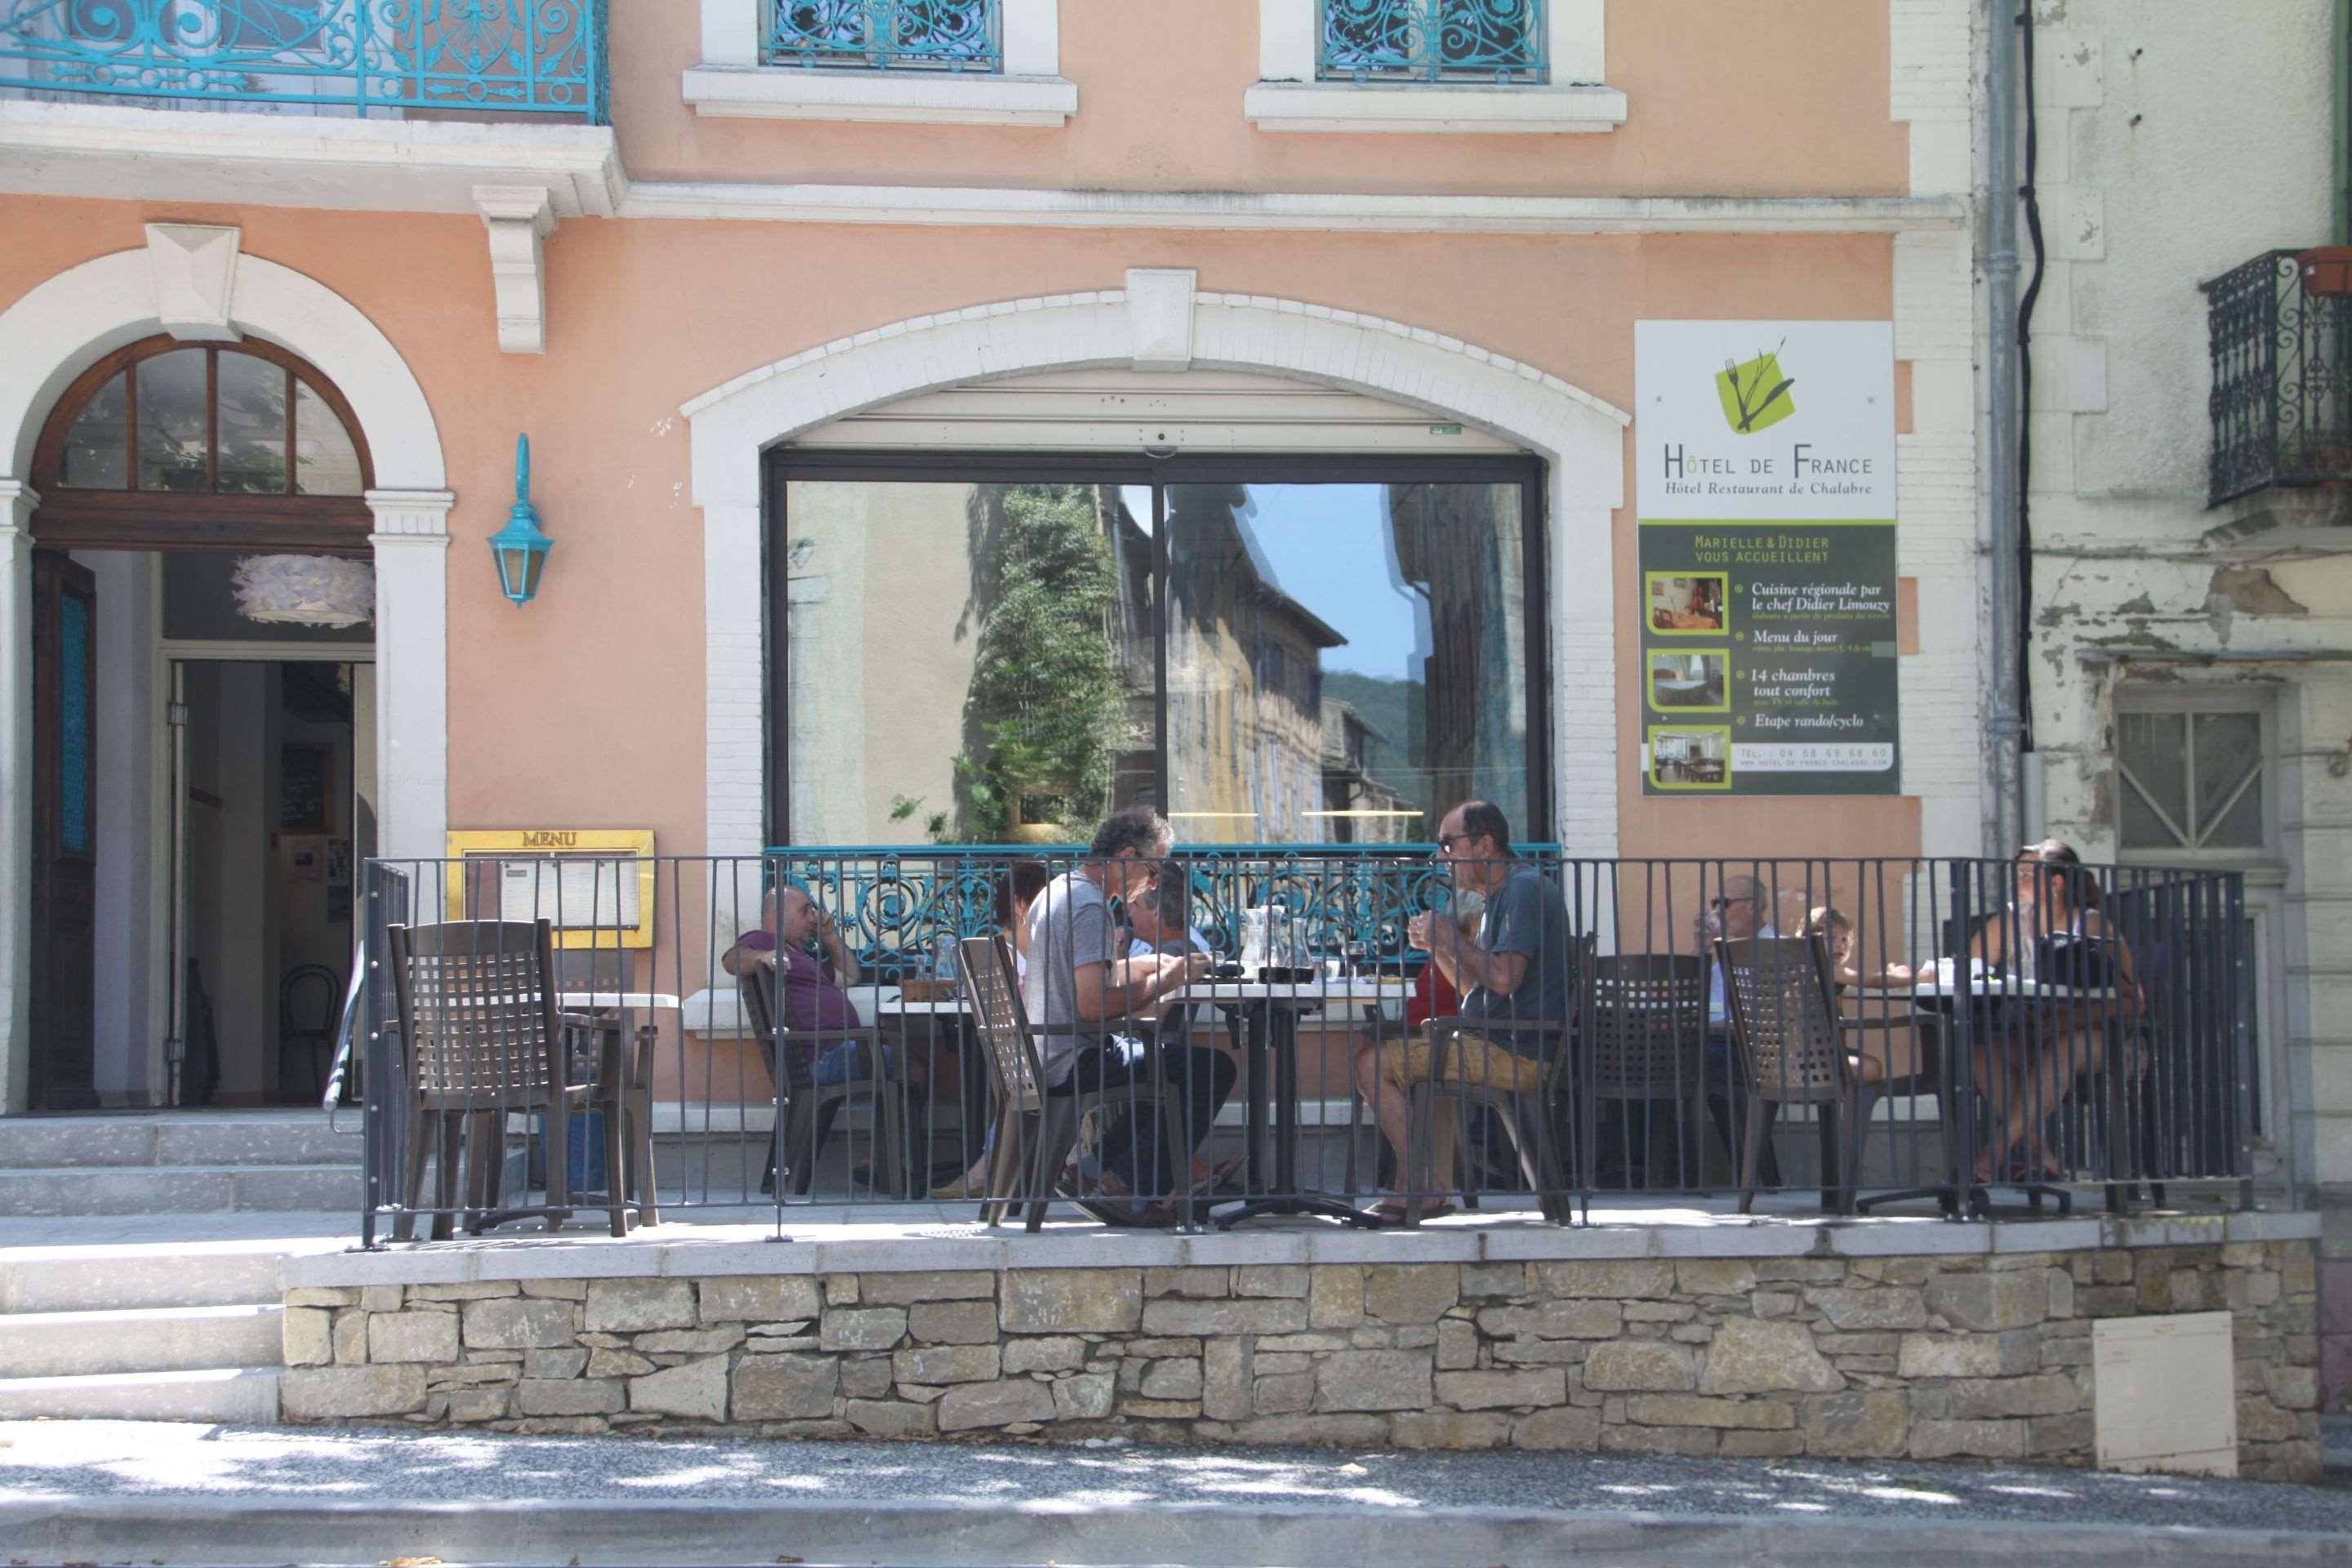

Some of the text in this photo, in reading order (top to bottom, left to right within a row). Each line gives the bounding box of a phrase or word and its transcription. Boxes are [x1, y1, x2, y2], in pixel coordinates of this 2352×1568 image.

[1750, 459, 1774, 474] DE
[1794, 443, 1873, 479] FRANCE
[1665, 482, 1872, 494] Hôtel Restaurant de Chalabre
[1695, 535, 1829, 549] MARIELLE & DIDIER
[1695, 551, 1829, 563] VOUS ACCUEILLENT
[1752, 582, 1882, 598] Cuisine régionale par
[1752, 597, 1890, 612] le chef Didier Limouzy
[1753, 629, 1838, 645] Menu du jour
[1751, 668, 1835, 682] 14 chambres
[1753, 684, 1831, 698] tout confort
[1755, 714, 1864, 729] Etape rando/cyclo
[522, 831, 577, 847] MENU
